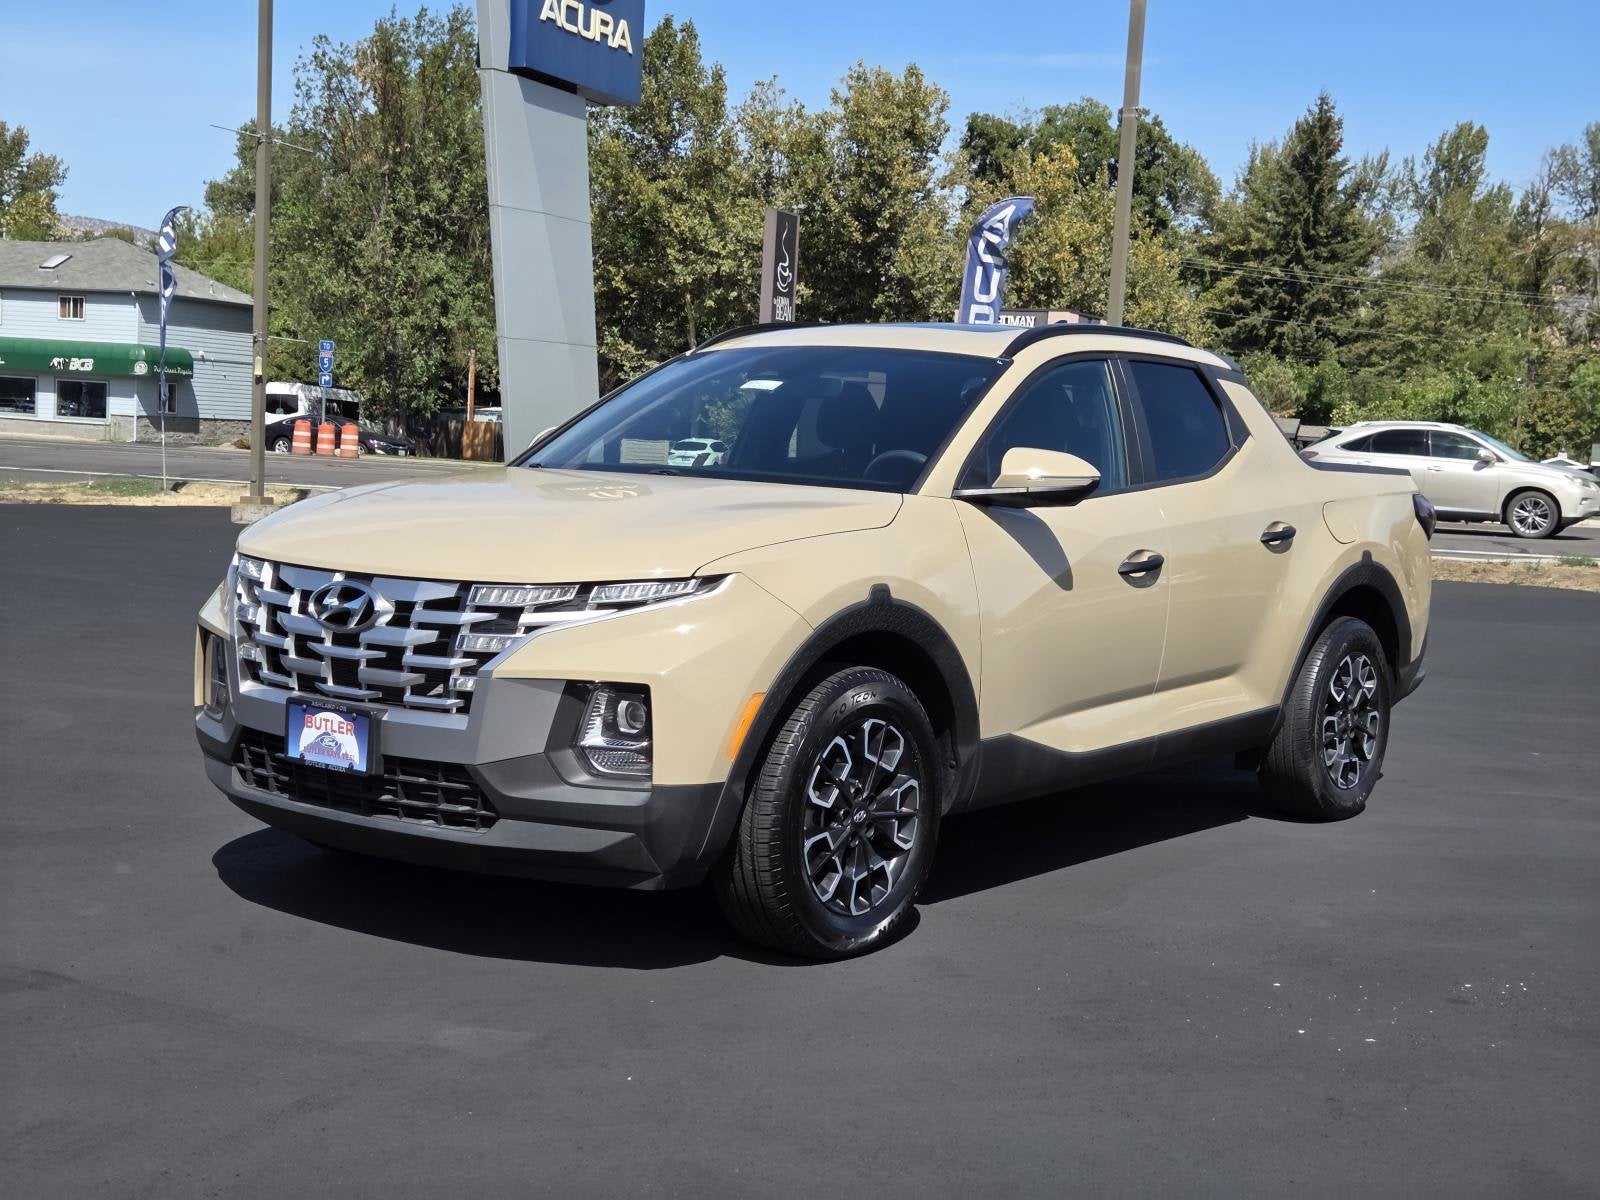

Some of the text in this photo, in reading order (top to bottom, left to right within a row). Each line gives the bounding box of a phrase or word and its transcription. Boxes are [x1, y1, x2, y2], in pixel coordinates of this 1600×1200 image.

[540, 0, 633, 54] ACURA
[324, 358, 329, 368] 5
[304, 714, 355, 736] BUTLER
